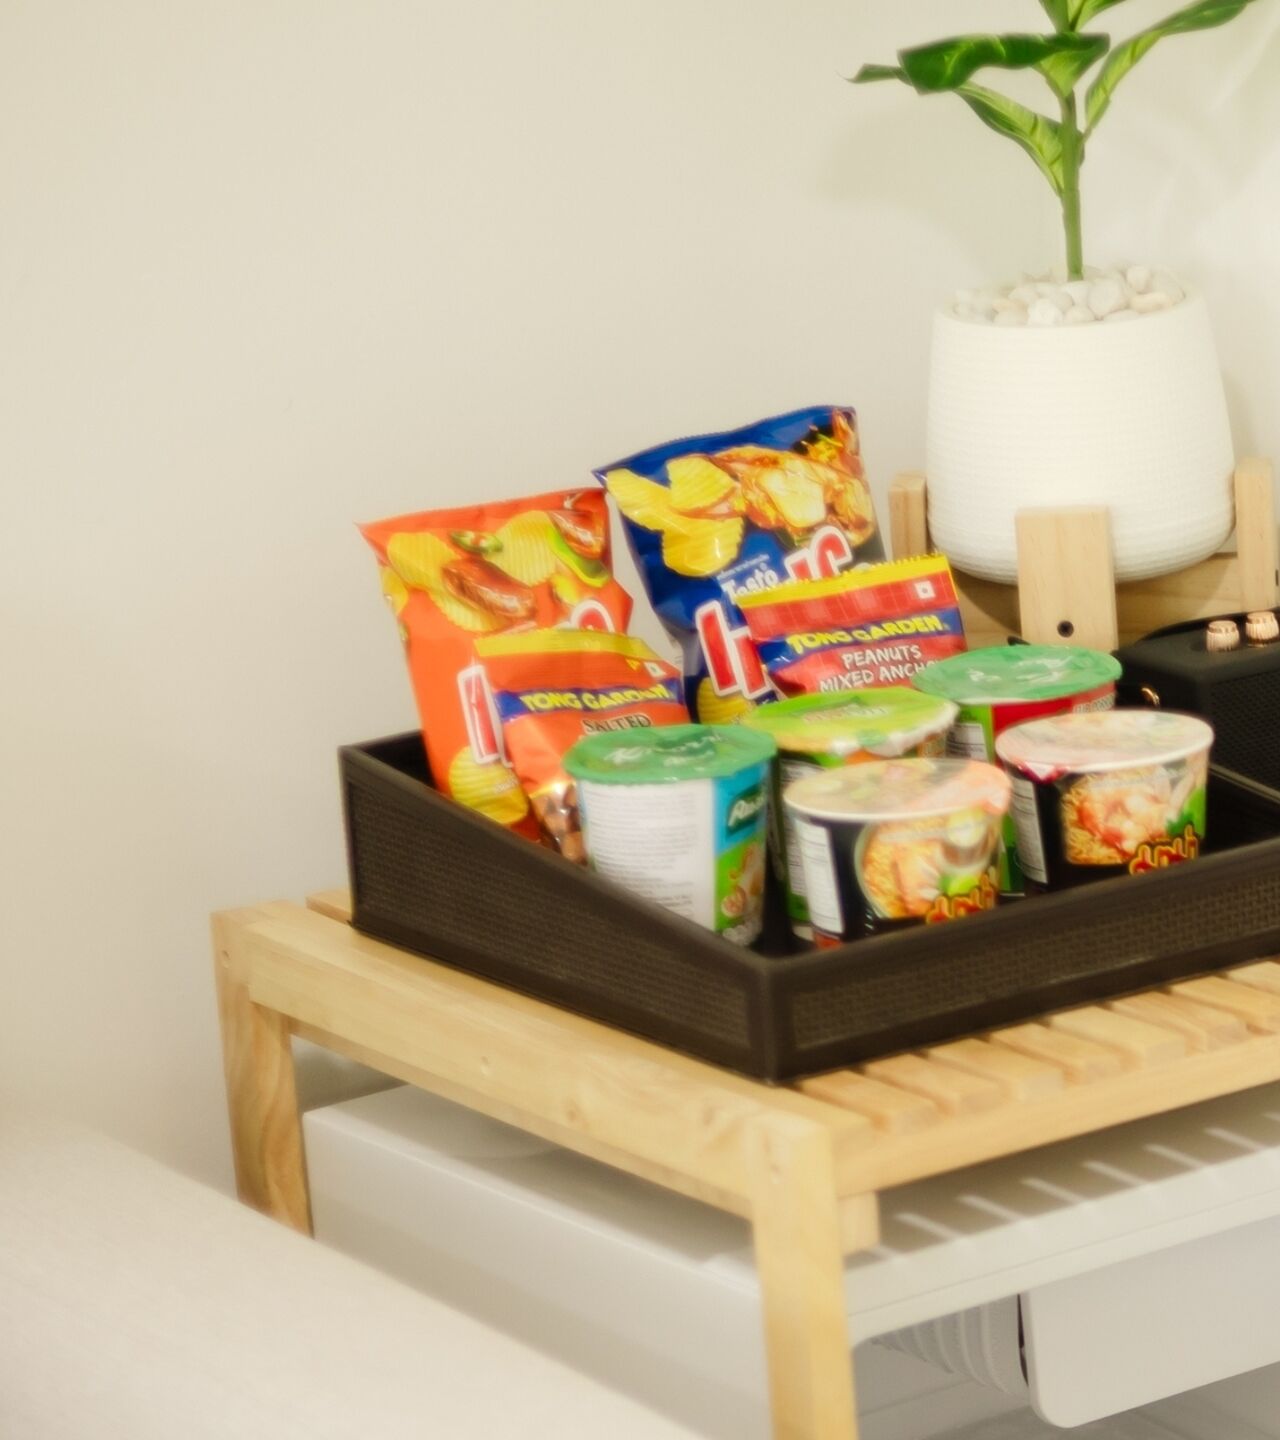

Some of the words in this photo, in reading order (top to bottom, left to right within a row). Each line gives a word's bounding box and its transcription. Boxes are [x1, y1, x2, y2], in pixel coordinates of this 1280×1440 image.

[786, 630, 850, 654] TONG
[851, 614, 943, 643] GARDEN
[841, 644, 922, 669] PEANUTS
[819, 668, 875, 692] MIXED
[519, 692, 582, 711] TONG
[581, 683, 670, 710] GARDEN
[581, 713, 652, 734] SALTED
